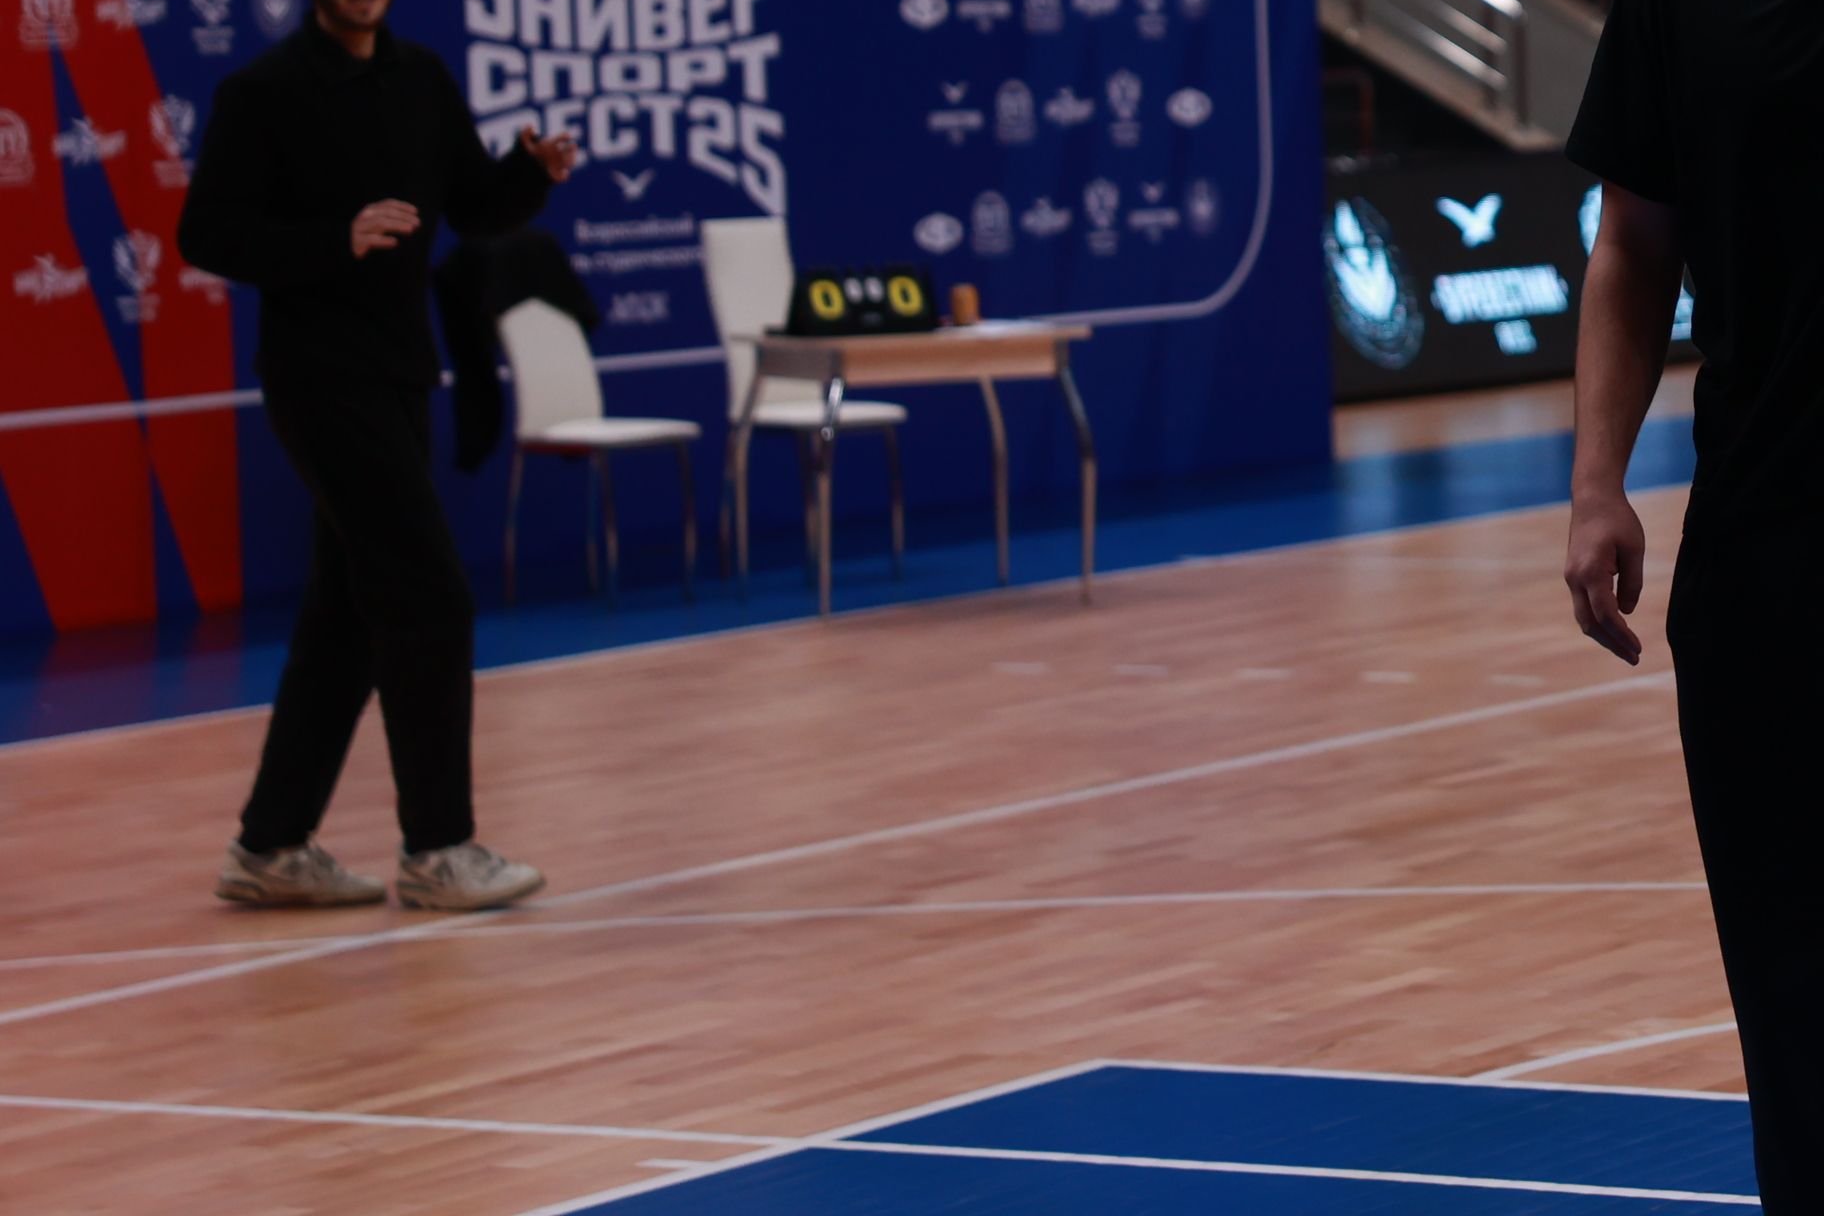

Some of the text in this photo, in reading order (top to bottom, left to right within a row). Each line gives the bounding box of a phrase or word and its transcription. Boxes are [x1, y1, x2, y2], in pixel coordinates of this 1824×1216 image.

[466, 32, 781, 113] СПОРТ
[809, 278, 845, 320] 0
[887, 275, 924, 317] 0
